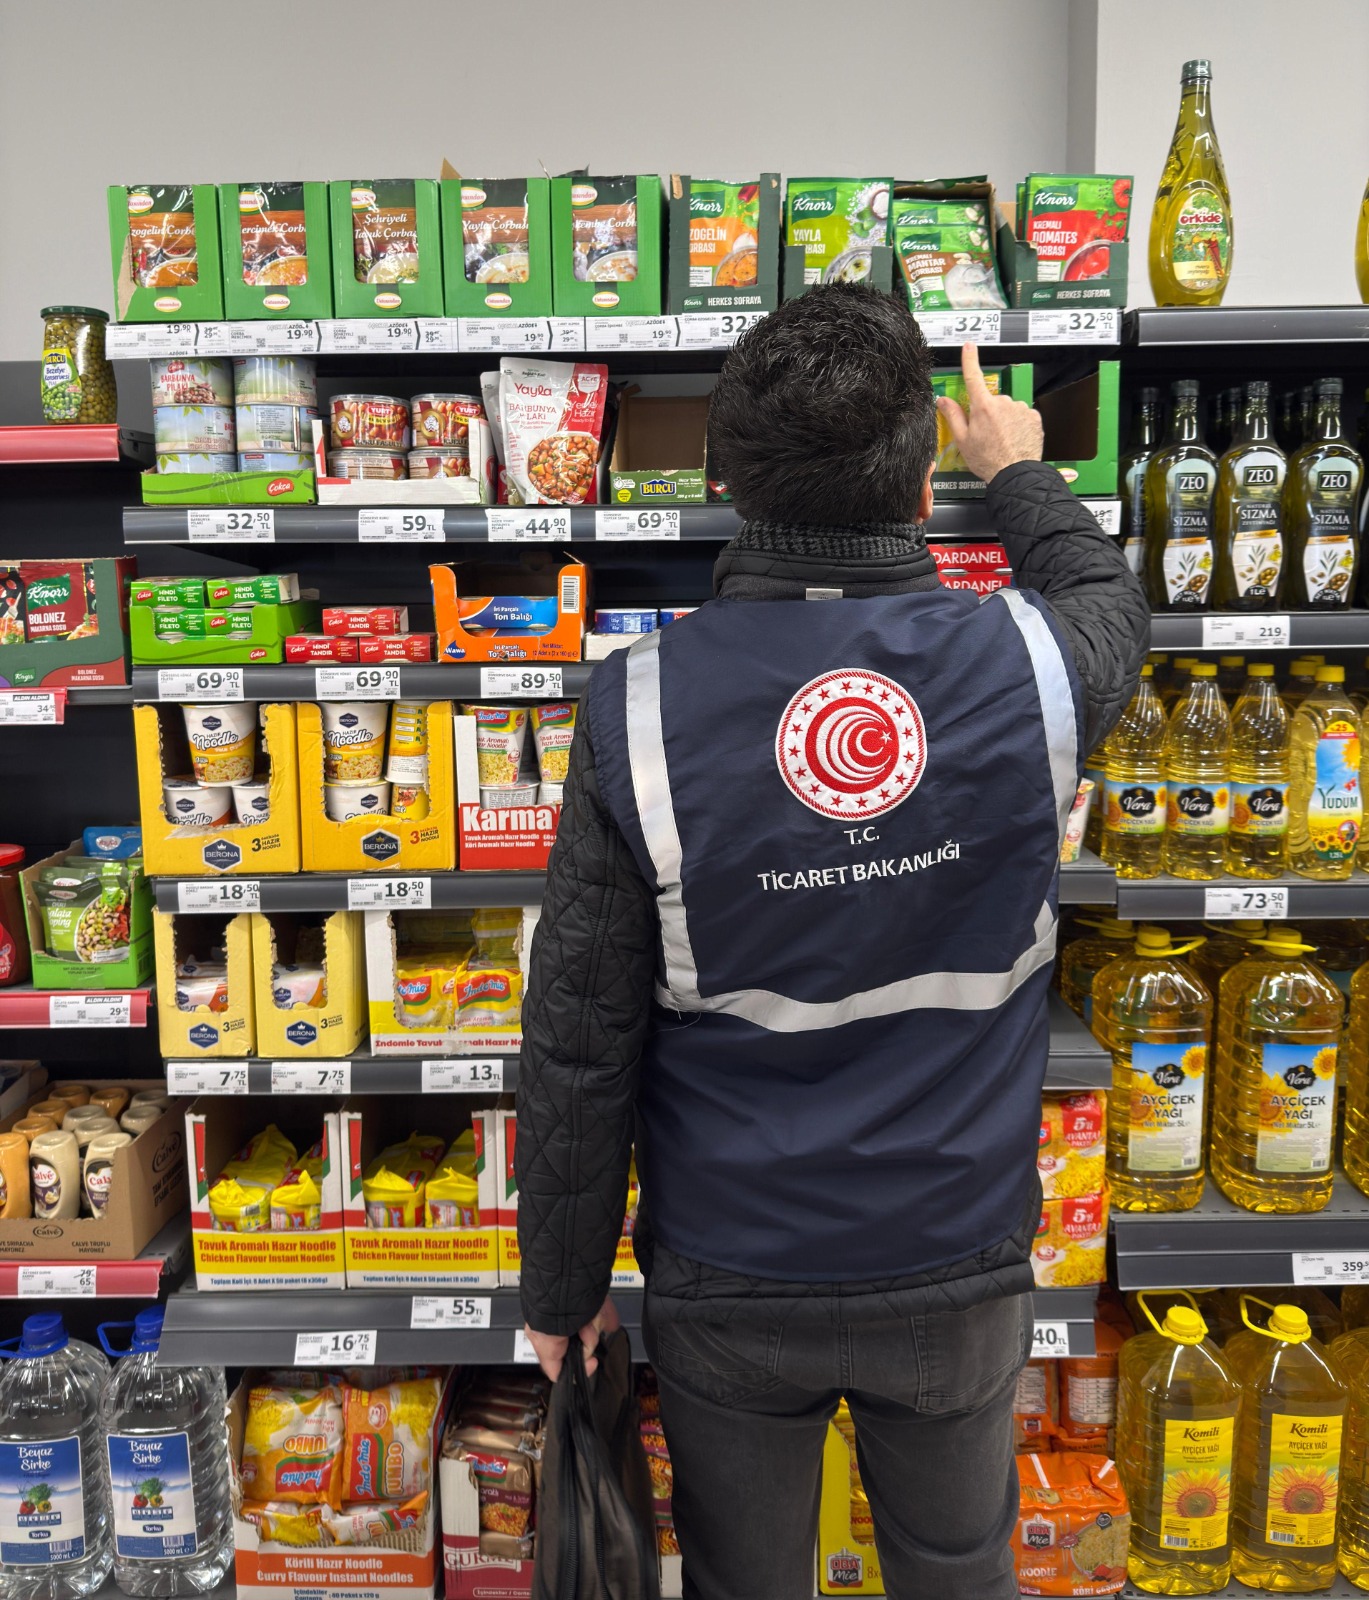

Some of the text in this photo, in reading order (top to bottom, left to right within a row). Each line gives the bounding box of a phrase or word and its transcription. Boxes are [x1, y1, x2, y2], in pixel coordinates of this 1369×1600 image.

[794, 198, 834, 212] Knorr
[1034, 192, 1076, 206] Knorr
[1033, 220, 1062, 230] KREMALI
[1180, 213, 1222, 226] orkide
[690, 228, 726, 242] ZOGELİN
[793, 229, 822, 242] YAYLA
[1032, 232, 1078, 244] DOMATES
[902, 242, 939, 251] Knorr
[908, 258, 946, 272] MANTAR
[708, 295, 762, 306] HERKES SOFRAYA
[1056, 288, 1110, 300] HERKES SOFRAYA
[954, 314, 999, 332] 32,50
[1068, 312, 1113, 330] 32,50
[160, 373, 196, 384] BARBUNYA
[514, 383, 552, 398] Yayla
[371, 406, 390, 414] YURT
[460, 406, 478, 414] YURT
[1180, 476, 1204, 490] ZEO
[1248, 470, 1274, 483] ZEO
[1322, 474, 1348, 488] ZEO
[268, 482, 292, 494] Çokça
[642, 484, 675, 494] BURCU
[933, 481, 987, 490] HERKES SOFRAYA
[638, 512, 678, 528] 69,50
[1240, 508, 1277, 520] SIZMA
[1314, 514, 1350, 525] SIZMA
[227, 512, 270, 530] 32,50
[402, 516, 426, 532] 59
[526, 518, 566, 534] 44,90
[1173, 516, 1208, 526] SIZMA
[934, 552, 1004, 564] DARDANEL
[27, 586, 70, 600] Knorr
[158, 588, 176, 596] HİNDİ
[234, 592, 255, 600] FİLETO
[29, 612, 66, 624] BOLONEZ
[510, 613, 532, 622] Balığı
[30, 624, 52, 632] MAKARNA
[1260, 627, 1282, 637] 219
[196, 672, 239, 688] 69,90
[356, 670, 398, 687] 69,90
[521, 672, 562, 689] 89,50
[193, 732, 238, 750] Noodle
[328, 729, 373, 748] Noodle
[1124, 797, 1152, 810] Vera
[1318, 784, 1359, 810] YUDUM
[1180, 797, 1209, 811] Vera
[1252, 798, 1280, 811] Vera
[462, 806, 553, 832] Karma
[410, 830, 419, 844] 3
[844, 826, 880, 846] T.C.
[252, 838, 262, 852] 3
[364, 842, 397, 850] BERONA
[515, 840, 536, 848] Noodle
[206, 850, 238, 858] BERONA
[758, 839, 960, 891] TİCARET BAKANLIĞI
[220, 884, 260, 900] 18,50
[385, 882, 424, 898] 18,50
[1243, 892, 1284, 910] 73,50
[50, 918, 72, 929] oping
[223, 1021, 230, 1032] 3
[320, 1018, 328, 1029] 3
[190, 1032, 217, 1040] BERONA
[288, 1029, 316, 1037] BERONA
[220, 1070, 246, 1086] 7,75
[318, 1070, 344, 1086] 7,75
[470, 1065, 492, 1080] 13
[1156, 1072, 1181, 1086] Vera
[1286, 1072, 1312, 1086] Vera
[1140, 1093, 1196, 1106] AYÇİÇEK
[1270, 1094, 1326, 1107] AYÇİÇEK
[1154, 1106, 1182, 1119] YAĞI
[1284, 1108, 1313, 1120] YAĞI
[36, 1226, 62, 1237] Calvé
[198, 1239, 336, 1251] Tavuk Aromalı Hazır Noodle
[350, 1238, 489, 1249] Tavuk Aromalı Hazır Noodle
[200, 1253, 335, 1263] Chicken Flavour Instant Noodles
[352, 1251, 488, 1260] Chicken Flavour Instant Noodles
[80, 1278, 91, 1286] 65
[452, 1299, 475, 1316] 55
[331, 1333, 370, 1352] 16,75
[1034, 1328, 1057, 1346] 40
[1182, 1426, 1220, 1442] Komili
[1290, 1422, 1328, 1438] Komili
[128, 1440, 164, 1454] Beyaz
[1182, 1444, 1220, 1455] AYÇİÇEK YAĞI
[1288, 1440, 1328, 1450] AYÇİÇEK YAĞI
[17, 1446, 54, 1460] Beyaz
[133, 1454, 162, 1465] Sirke
[21, 1459, 52, 1472] Sirke
[356, 1439, 372, 1496] Indomie
[386, 1442, 404, 1495] JUMBO
[1027, 1525, 1050, 1534] OBA
[1028, 1534, 1050, 1546] Mie
[285, 1557, 383, 1569] Körili Hazır Noodle
[831, 1559, 860, 1570] OBA
[257, 1570, 414, 1584] Curry Flavour Instant Noodles
[834, 1570, 858, 1580] Mie
